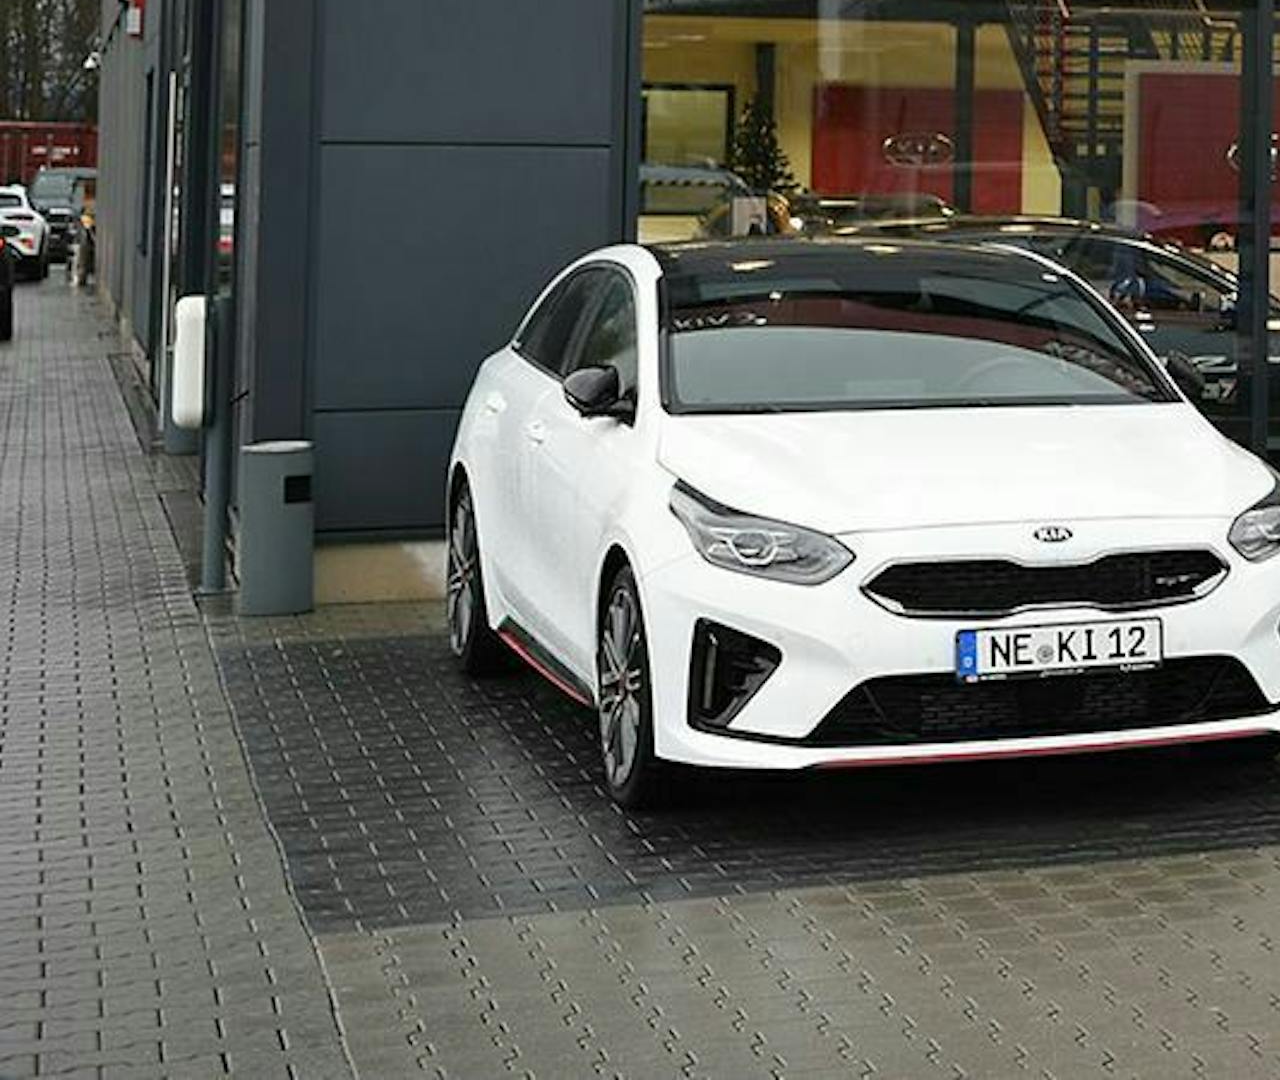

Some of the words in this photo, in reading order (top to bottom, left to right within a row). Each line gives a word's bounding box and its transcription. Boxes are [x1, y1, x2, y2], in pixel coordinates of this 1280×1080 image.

[991, 634, 1033, 667] NE
[1058, 630, 1097, 662] KI
[1109, 627, 1145, 658] 12
